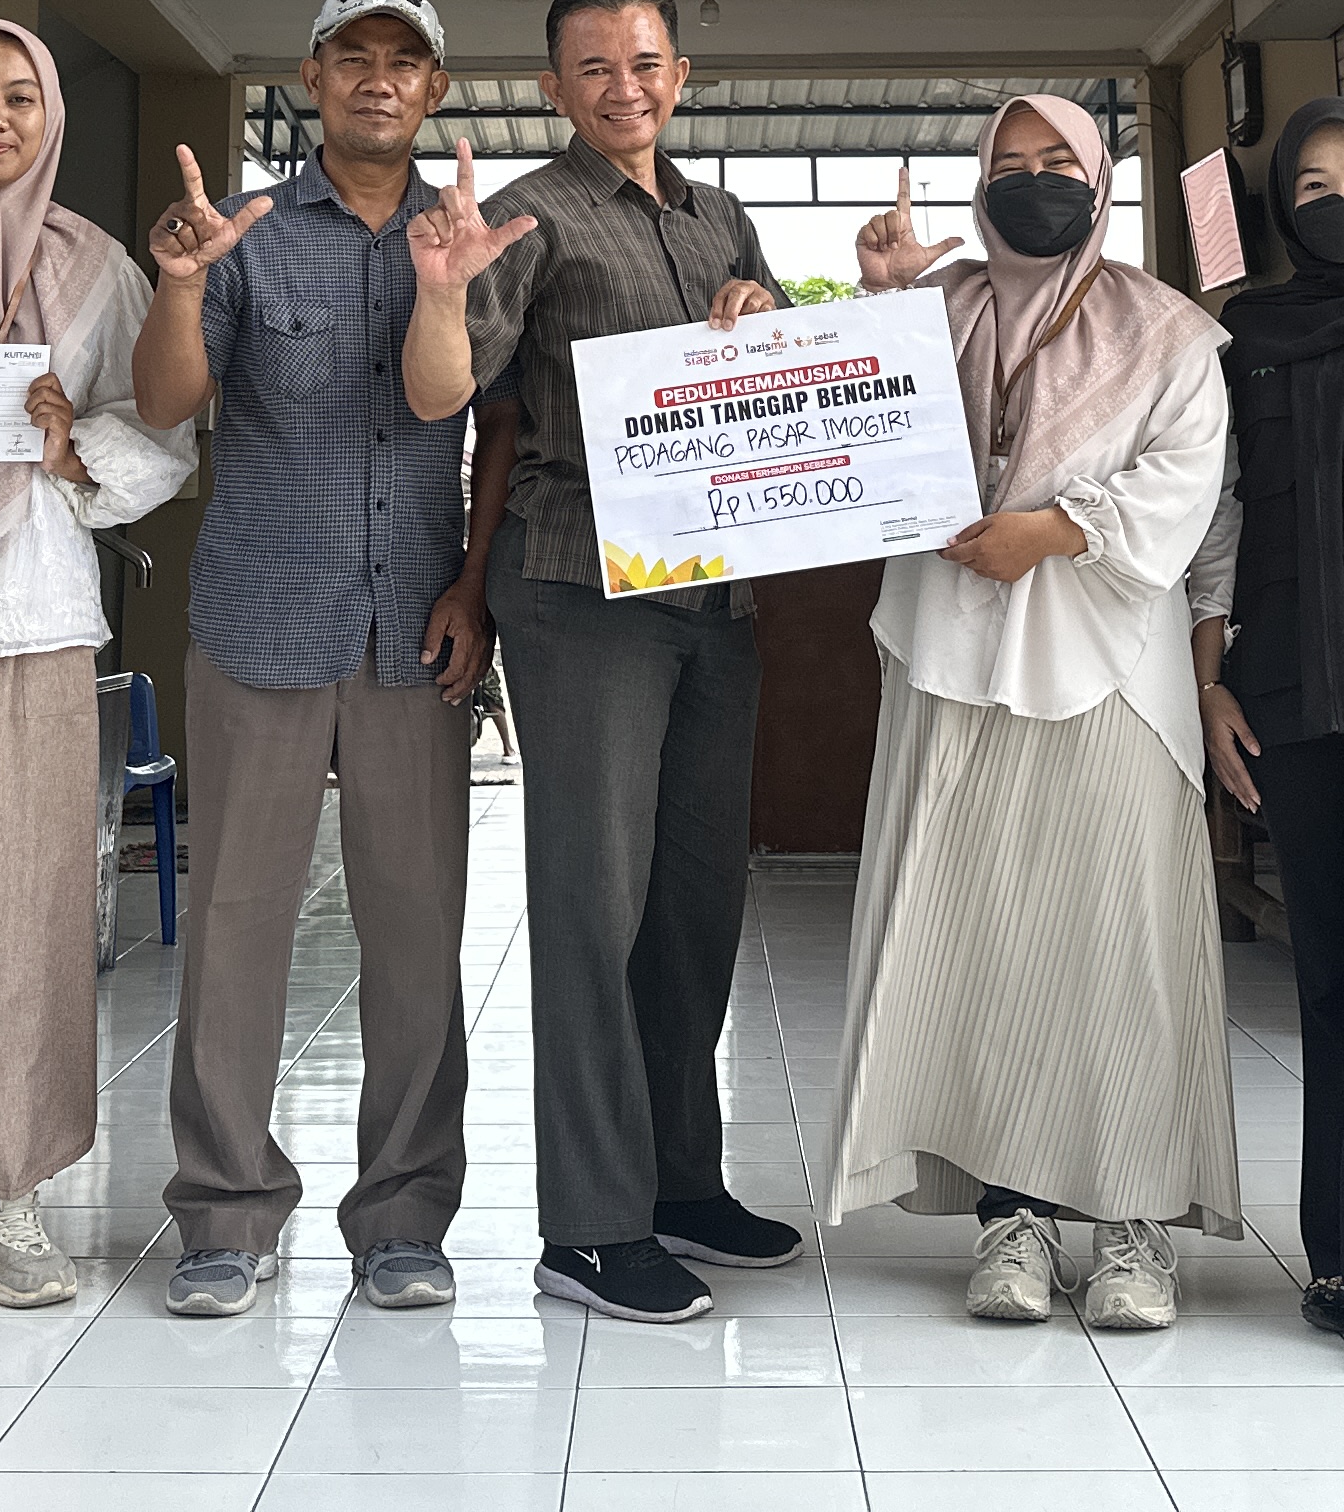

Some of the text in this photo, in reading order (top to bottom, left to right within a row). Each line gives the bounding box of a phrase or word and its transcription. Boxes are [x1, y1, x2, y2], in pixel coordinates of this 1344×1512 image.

[684, 354, 719, 367] siaga
[745, 340, 788, 354] lazismu
[661, 359, 873, 406] PEDULI KEMANUSIAAN
[624, 374, 917, 439] DONASI TANGGAP BENCANA
[615, 410, 912, 475] PEDAGANG PASAR IMOGIRI
[714, 472, 749, 484] DONASI
